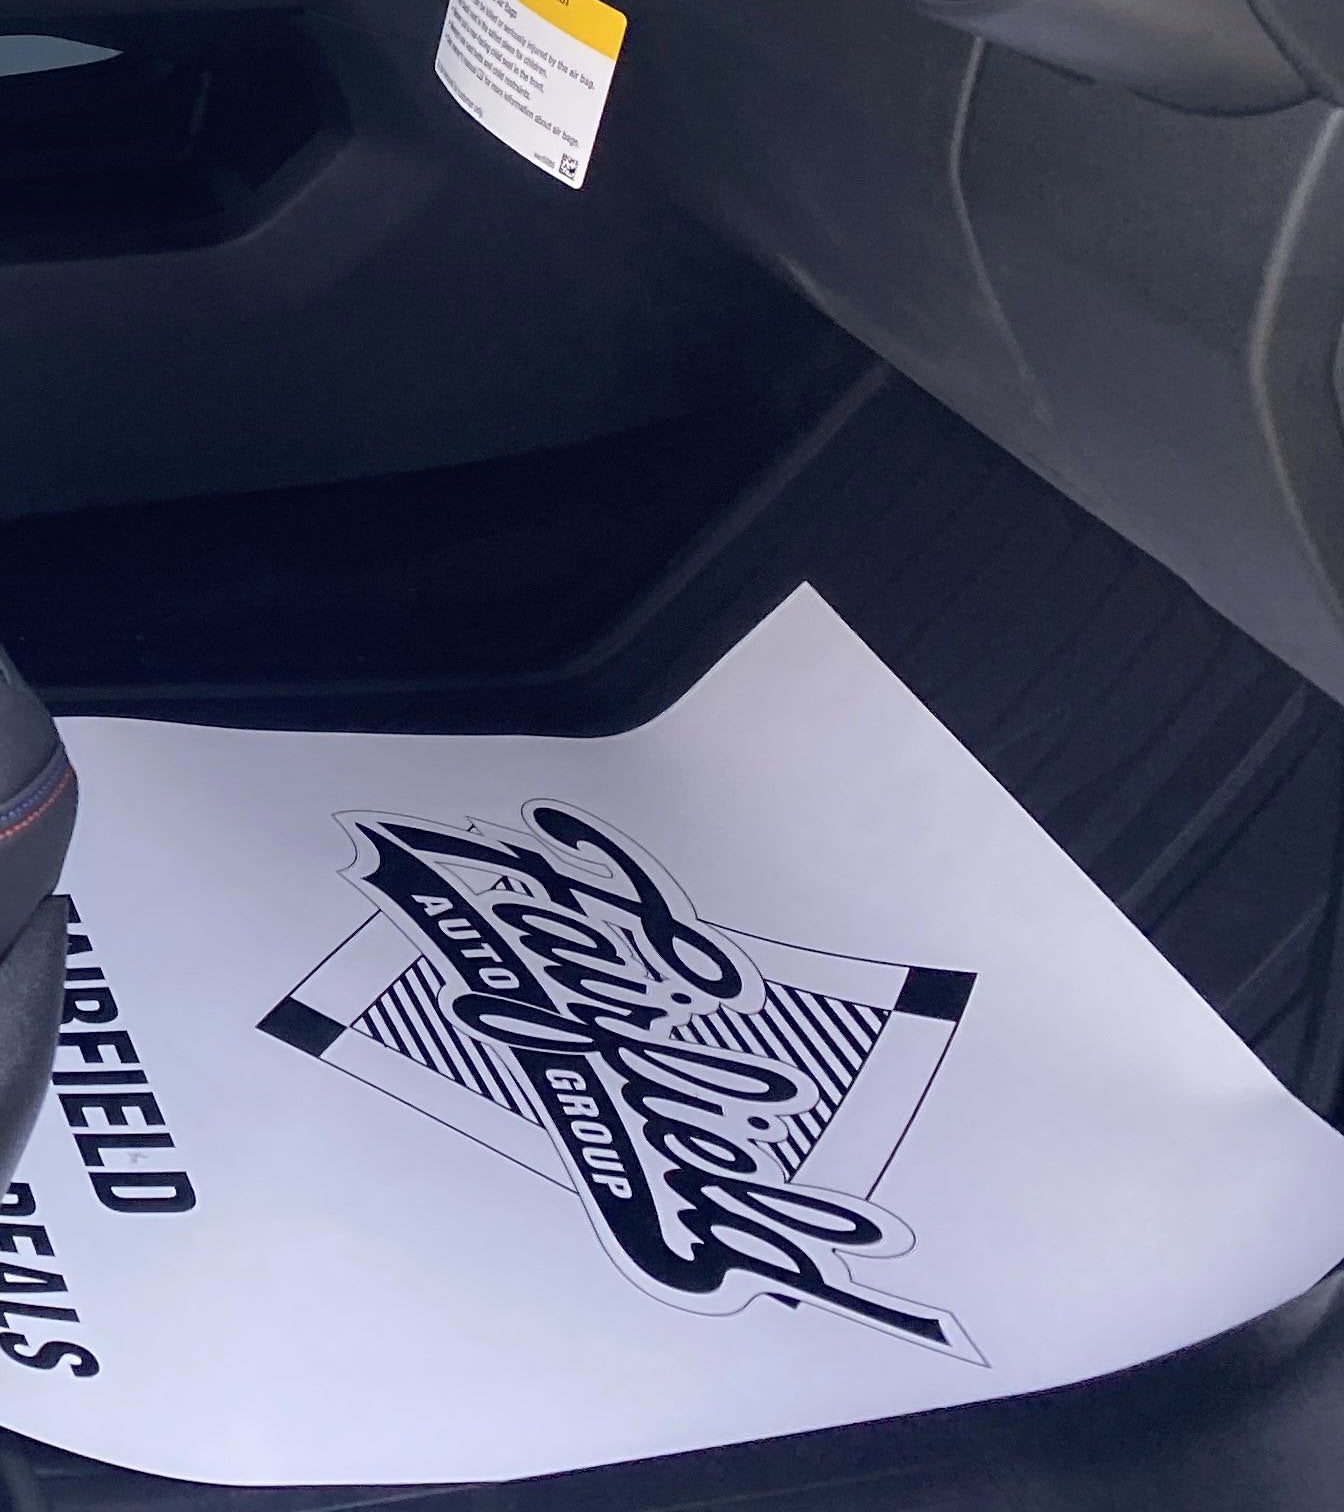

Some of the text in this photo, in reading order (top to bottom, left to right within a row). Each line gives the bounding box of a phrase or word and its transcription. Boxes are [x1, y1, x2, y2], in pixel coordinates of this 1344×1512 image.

[557, 60, 568, 73] the
[569, 69, 579, 80] air
[412, 893, 521, 991] AUTO
[355, 806, 950, 1345] Fairfield
[544, 1067, 633, 1201] GROUP
